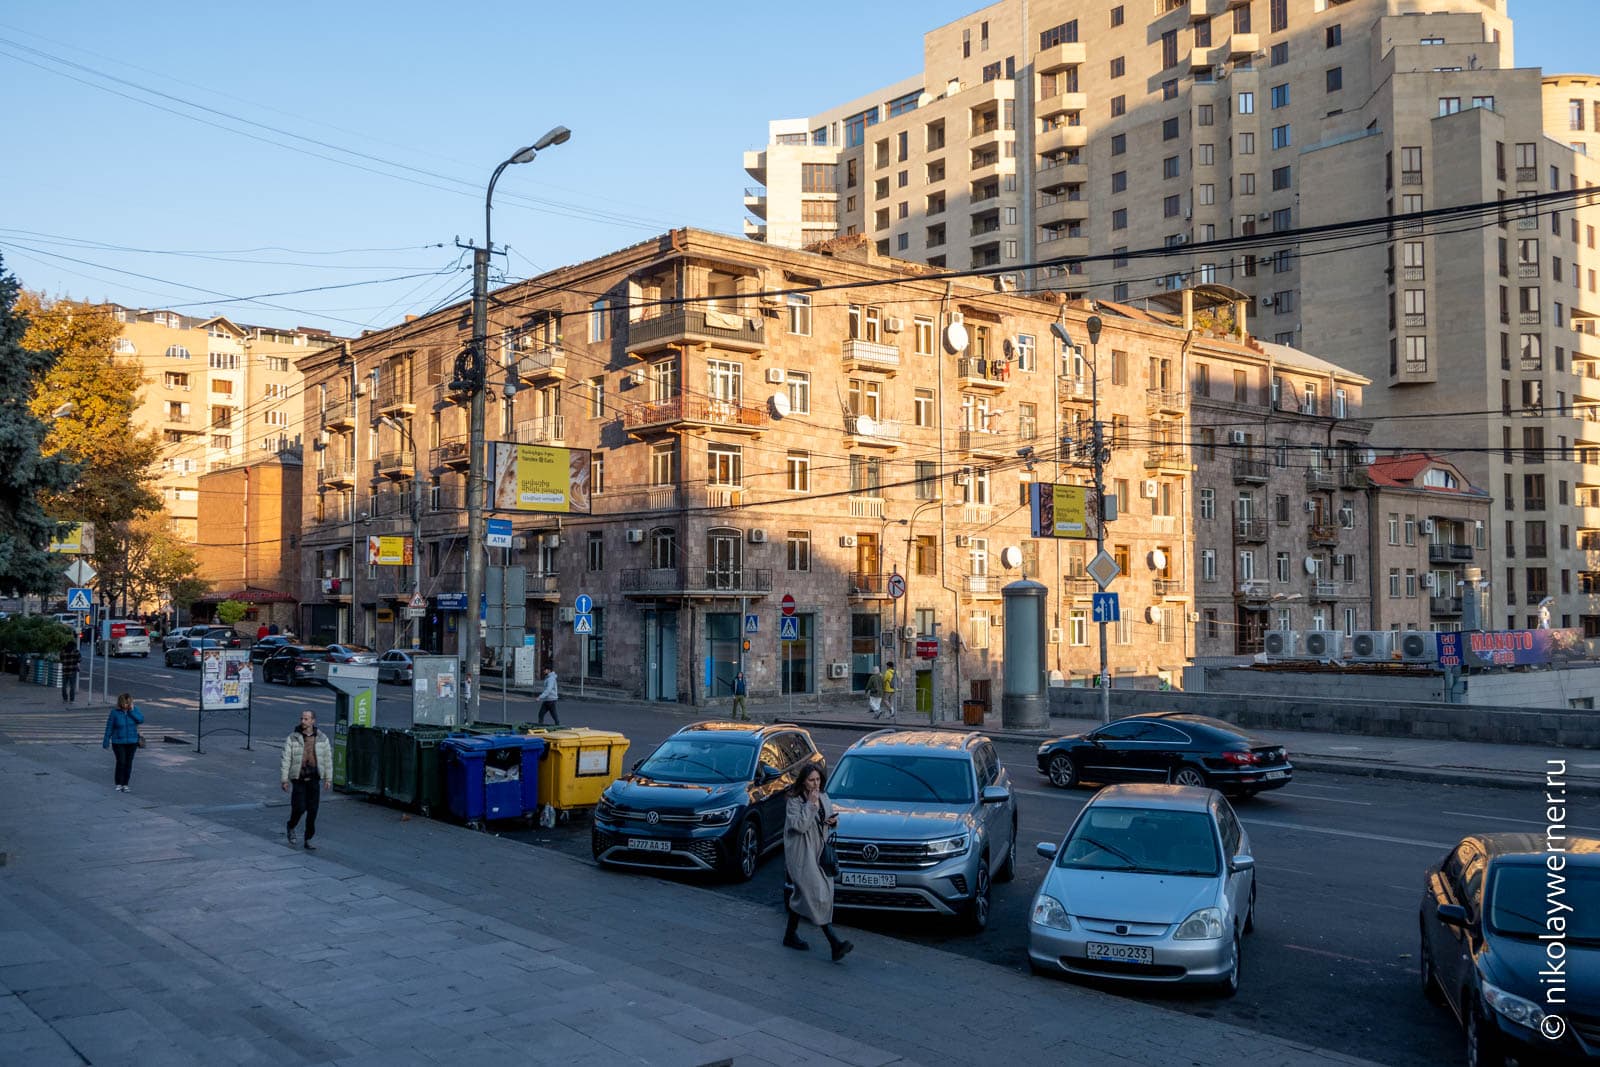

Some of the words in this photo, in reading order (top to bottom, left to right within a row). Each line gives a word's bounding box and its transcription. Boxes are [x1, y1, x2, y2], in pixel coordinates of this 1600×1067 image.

[491, 536, 506, 544] ATM
[1470, 631, 1533, 651] MANOTO
[1096, 944, 1110, 956] 22
[1127, 947, 1148, 959] 233
